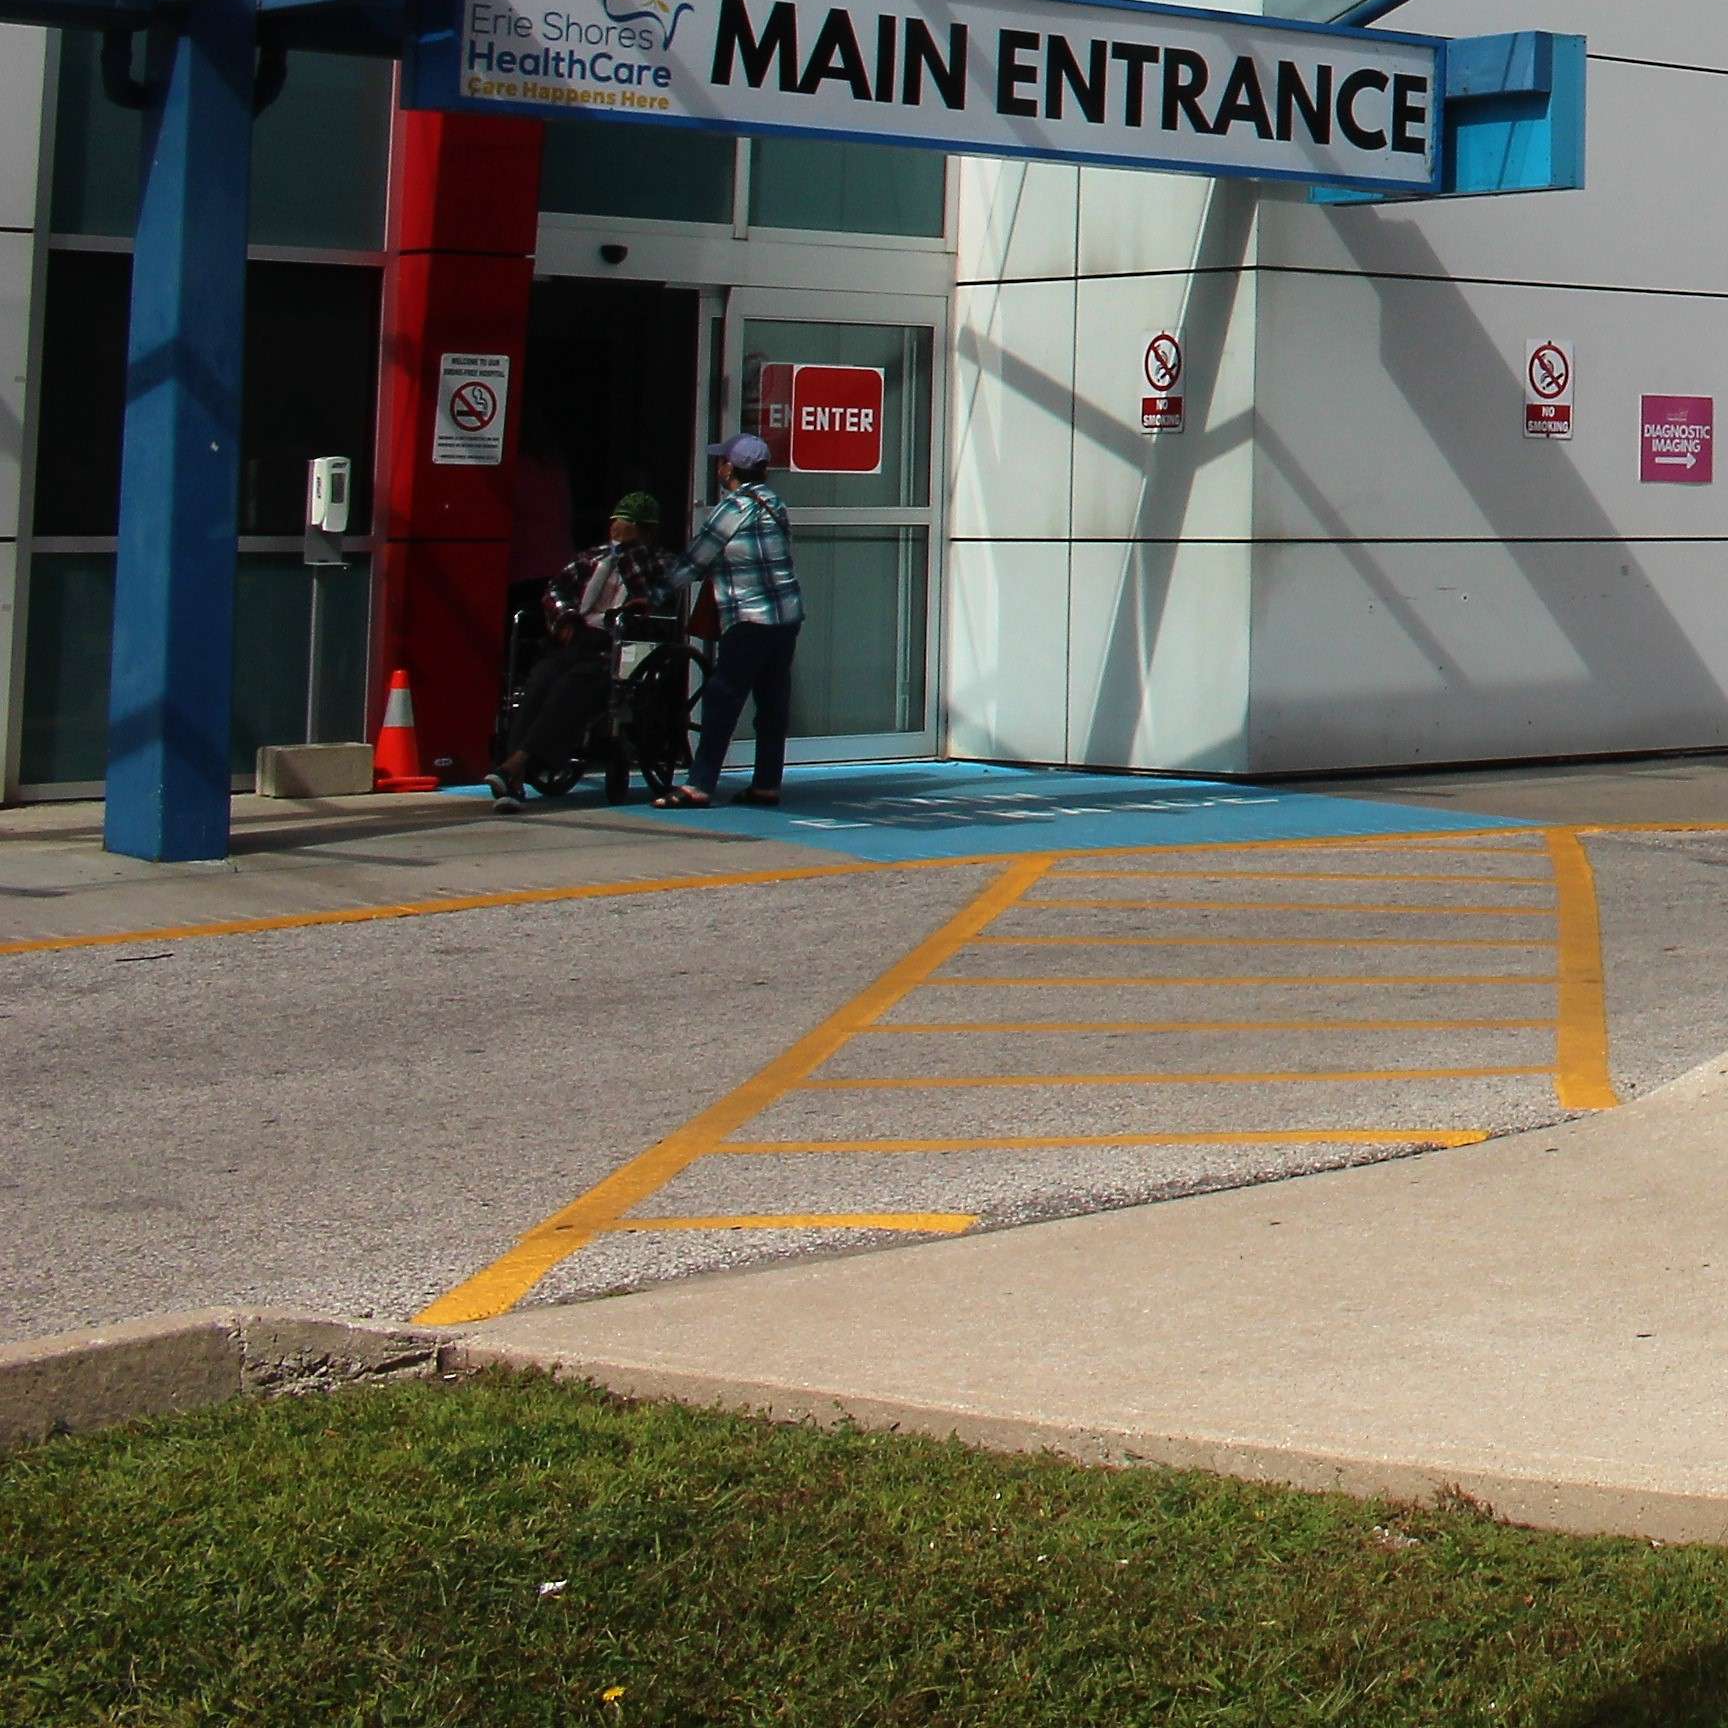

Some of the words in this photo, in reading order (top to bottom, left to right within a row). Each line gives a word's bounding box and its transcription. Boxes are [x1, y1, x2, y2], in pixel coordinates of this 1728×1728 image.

[470, 3, 534, 39] Erie
[542, 10, 654, 50] Shores
[467, 39, 672, 88] HealthCare
[467, 75, 518, 97] Care
[522, 81, 616, 106] Happens
[620, 91, 670, 110] Here
[996, 28, 1428, 155] ENTRANCE
[1155, 399, 1169, 411] NO
[1541, 405, 1556, 418] NO
[801, 406, 874, 432] ENTER
[1143, 414, 1181, 426] SMOKING
[1527, 420, 1569, 432] SMOKING
[1643, 424, 1711, 439] DIAGNOSTIC
[1651, 438, 1702, 453] IMAGING
